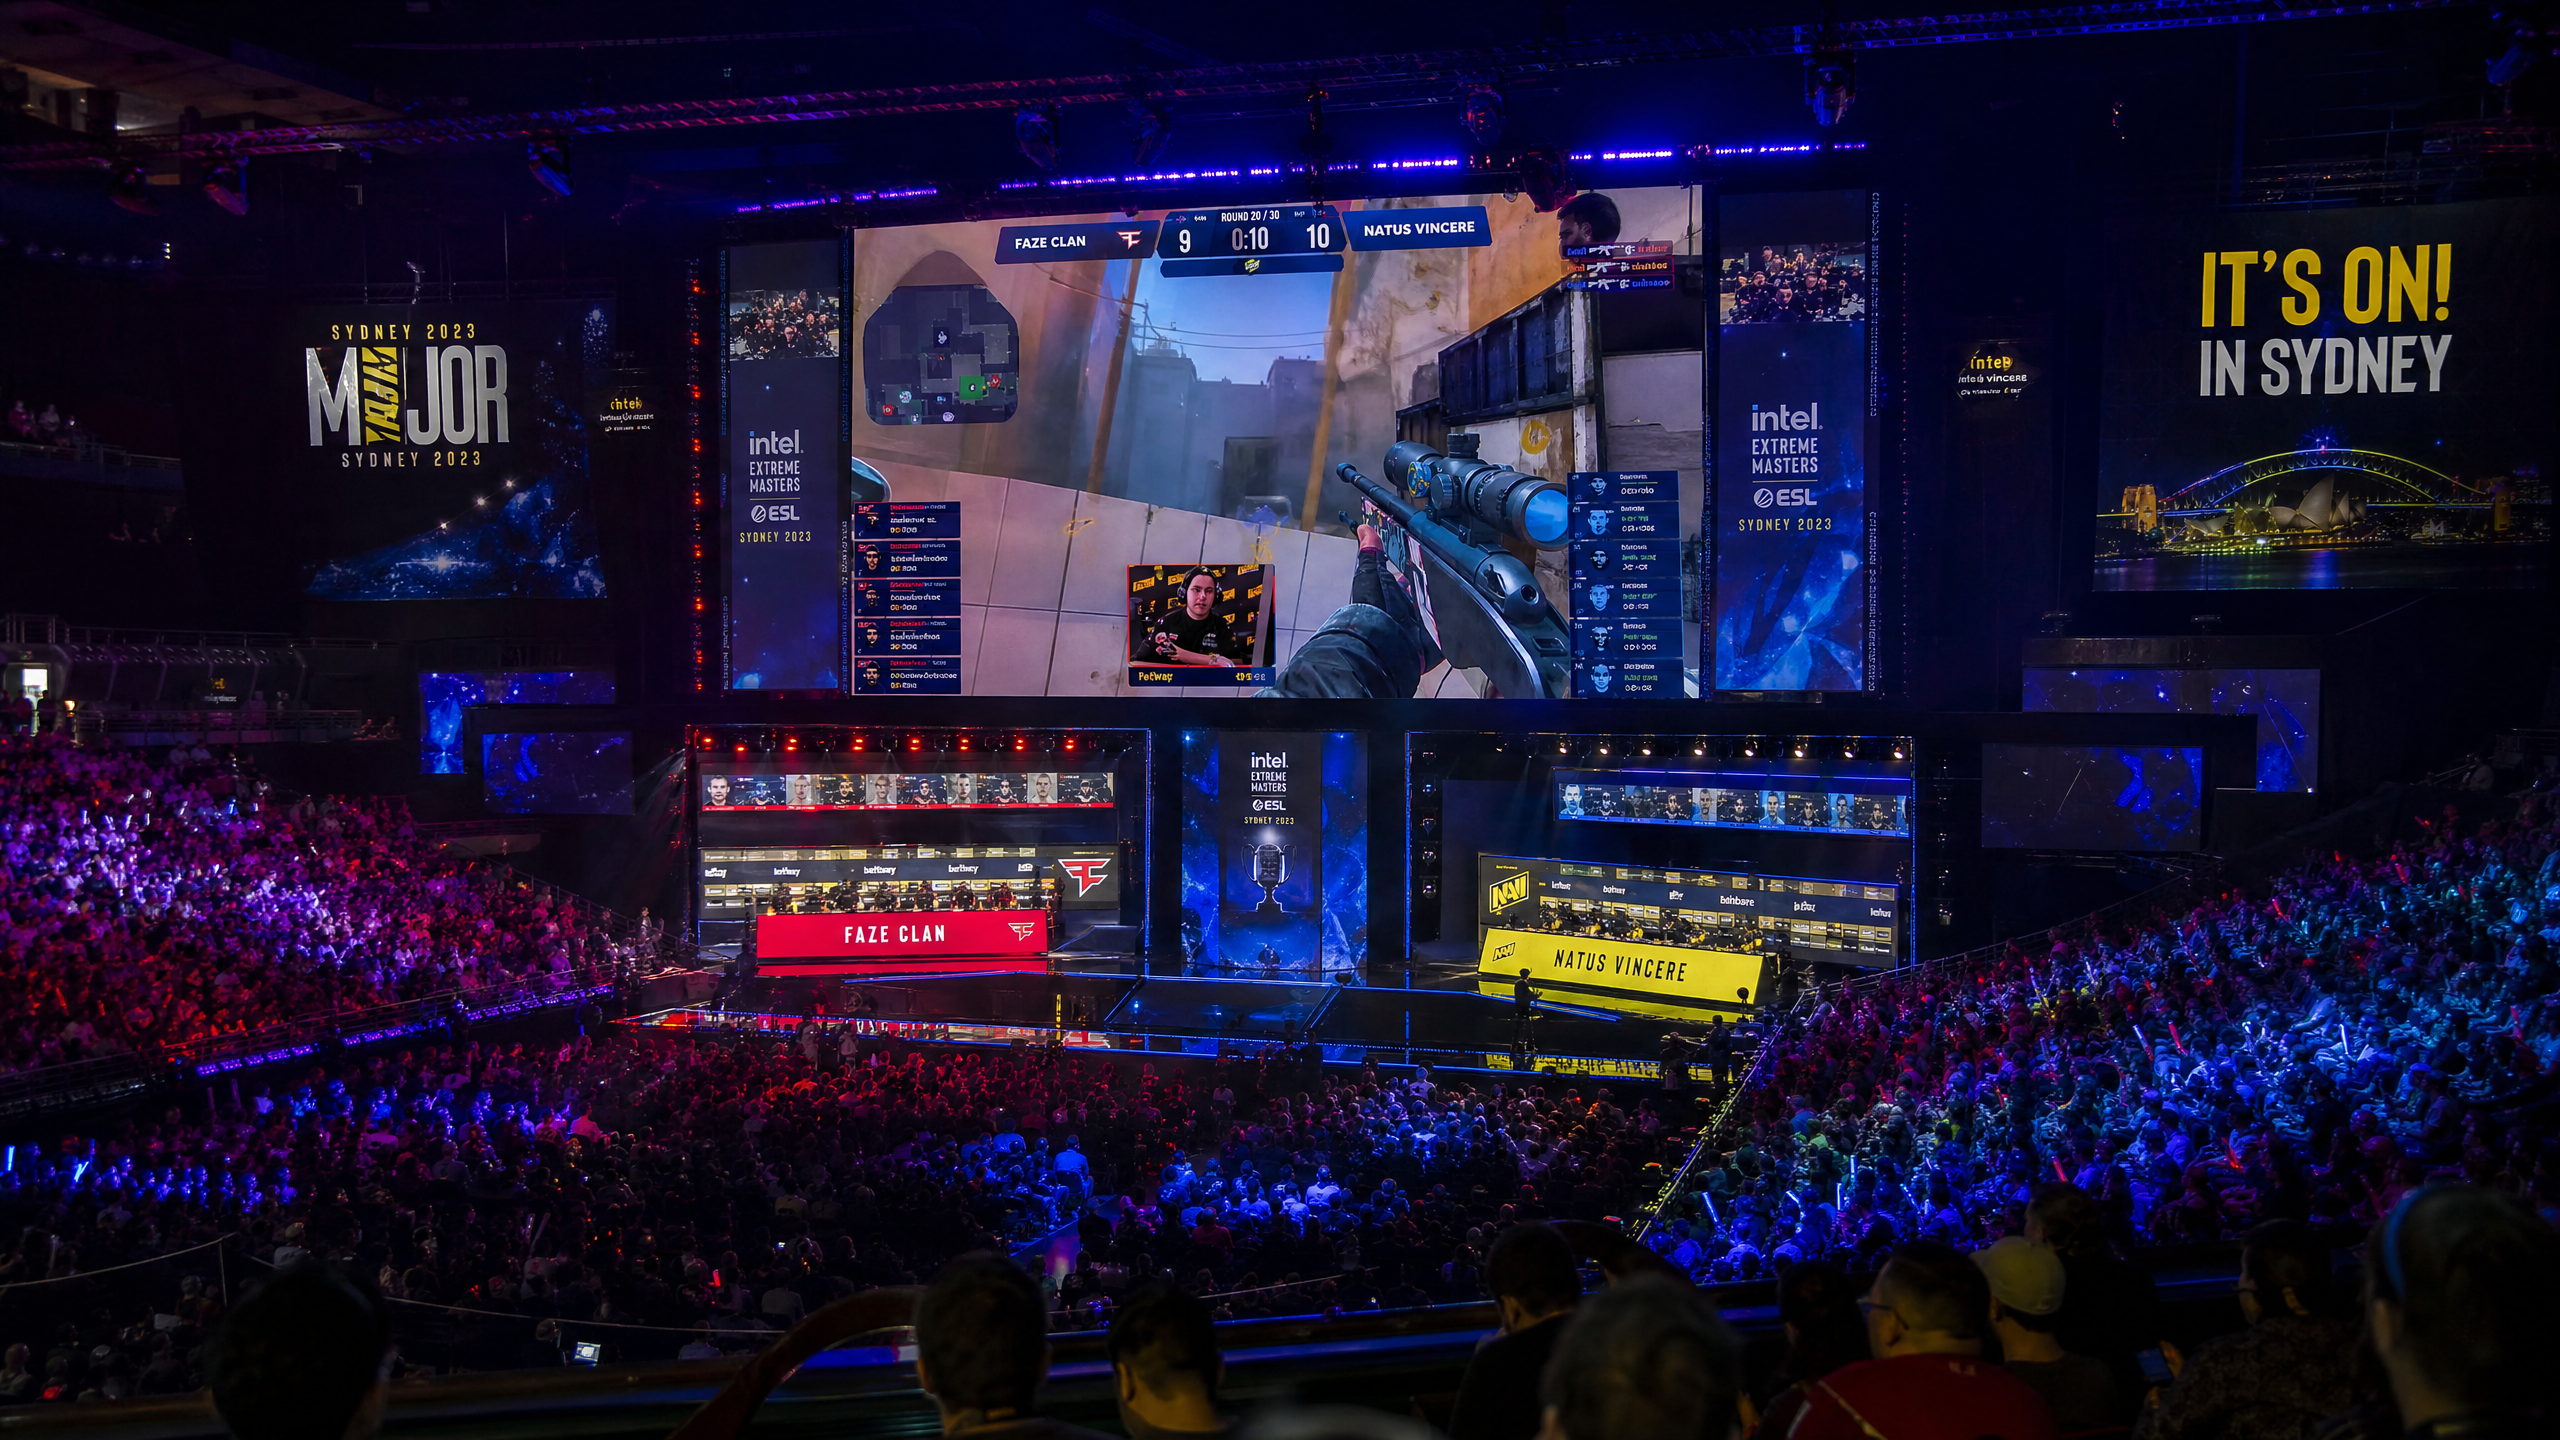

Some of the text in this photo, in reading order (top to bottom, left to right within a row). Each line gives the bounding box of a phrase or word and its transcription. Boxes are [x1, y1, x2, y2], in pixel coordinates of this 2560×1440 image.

[1221, 211, 1249, 222] ROUND
[1251, 211, 1261, 221] 20
[1269, 210, 1280, 220] 30
[1306, 223, 1330, 249] 10
[1364, 221, 1475, 237] NATUS VINCERE
[1015, 236, 1086, 249] FAZE CLAN
[1179, 229, 1191, 254] 9
[1231, 226, 1269, 251] 0:10
[2202, 243, 2452, 327] IT'S ON!
[331, 323, 475, 340] SYDNEY 2023
[2200, 334, 2453, 397] IN SYDNEY
[1752, 438, 1818, 455] EXTREME
[342, 451, 481, 468] SYDNEY 2023
[1752, 457, 1818, 474] MASTERS
[749, 460, 800, 476] EXTREME
[749, 477, 800, 493] MASTERS
[1776, 488, 1818, 506] ESL
[768, 505, 800, 521] ESL
[1738, 517, 1832, 531] SYDNEY 2023
[739, 531, 811, 543] SYDNEY 2023
[1251, 771, 1287, 781] EXTREME
[1251, 782, 1287, 792] MASTERS
[1264, 800, 1287, 811] ESL
[1244, 816, 1295, 825] SYDNEY 2023
[844, 924, 946, 944] FAZE CLAN
[1554, 948, 1687, 982] NATUS VINCERE
